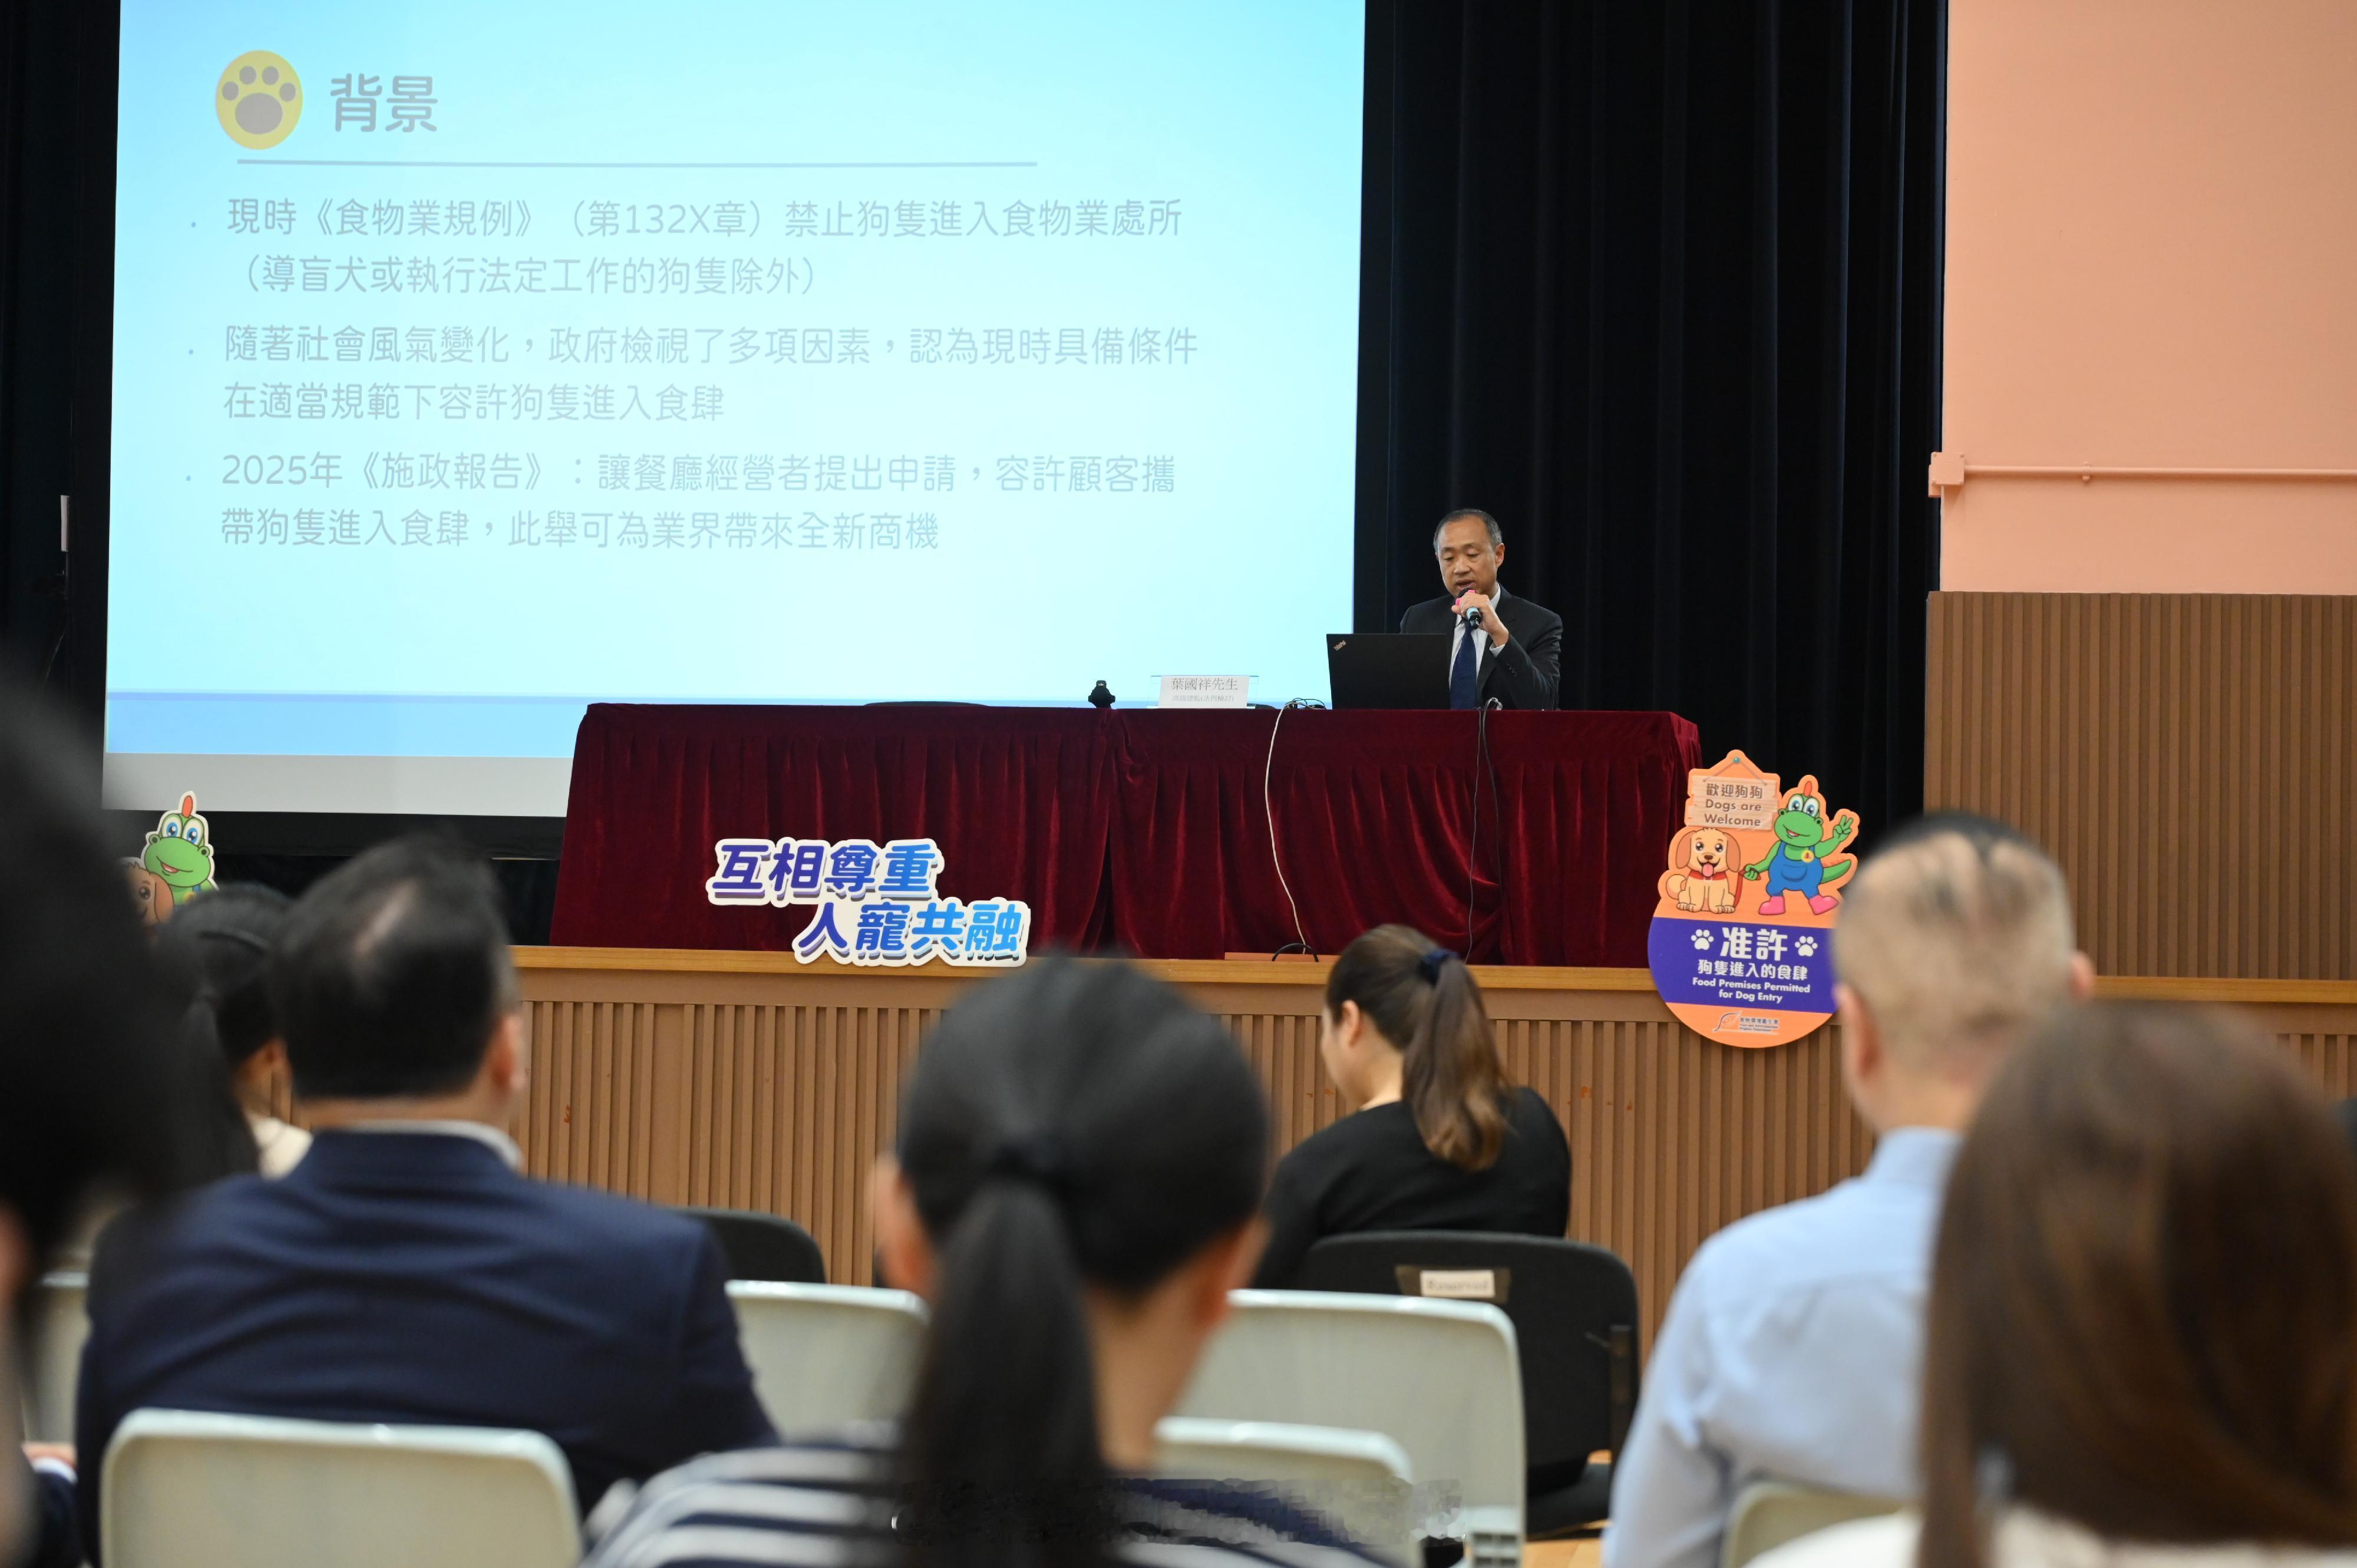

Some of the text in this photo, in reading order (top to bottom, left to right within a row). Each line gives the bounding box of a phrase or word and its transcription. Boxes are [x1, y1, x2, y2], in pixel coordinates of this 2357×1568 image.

[330, 73, 438, 133] 背景
[223, 381, 724, 422] 在適當規範下容許狗隻進入食肆
[1171, 678, 1238, 691] 葉國祥先生
[1706, 783, 1762, 799] 歡迎狗狗
[1706, 798, 1762, 812] Dogs are
[1704, 813, 1761, 826] Welcome
[712, 842, 936, 893] 互相尊重
[798, 902, 1022, 953] 人寵共融
[1719, 926, 1788, 962] 准許
[1698, 959, 1808, 981] 狗隻進入的食肆
[1692, 977, 1811, 993] Food Premises Permitted
[1719, 989, 1783, 1004] for Dog Entry
